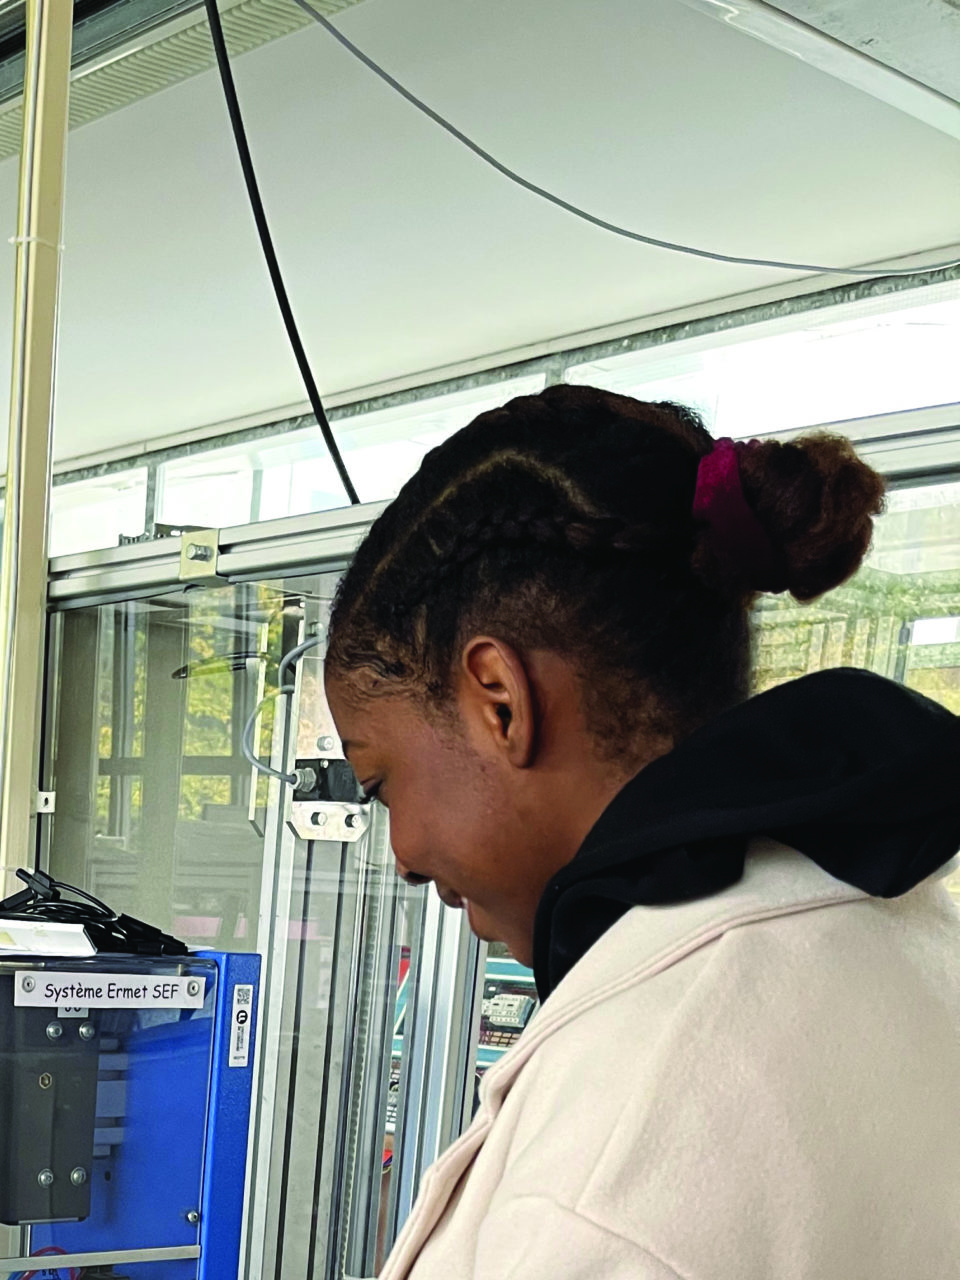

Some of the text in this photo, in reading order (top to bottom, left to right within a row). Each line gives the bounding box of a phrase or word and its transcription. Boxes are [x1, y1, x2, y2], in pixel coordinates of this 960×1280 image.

[44, 983, 180, 1002] Système Ermet SEF
